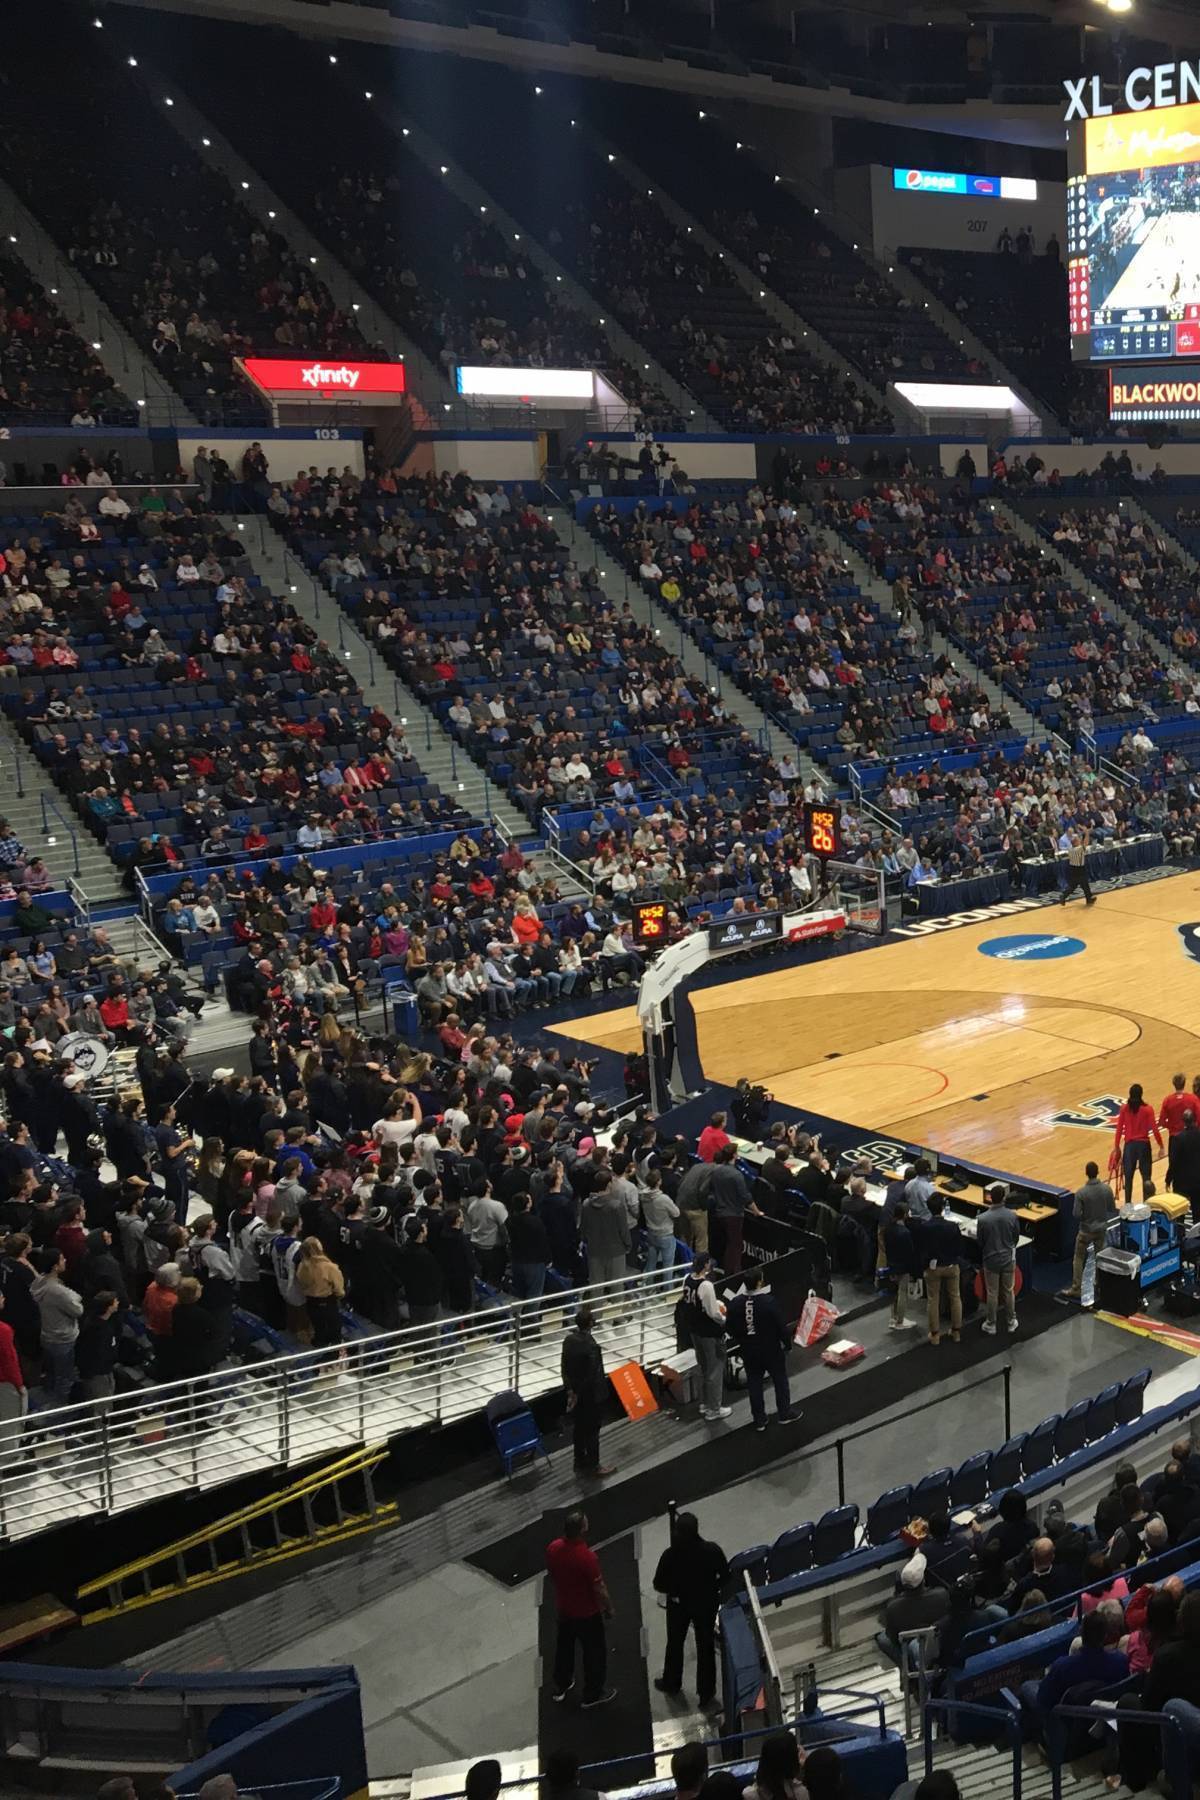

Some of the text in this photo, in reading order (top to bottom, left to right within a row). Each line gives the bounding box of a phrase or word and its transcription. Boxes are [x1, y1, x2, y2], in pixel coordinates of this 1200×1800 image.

[1063, 74, 1112, 121] XL
[967, 220, 988, 232] 207
[302, 364, 359, 388] xfinity
[314, 429, 339, 440] 103
[634, 432, 653, 442] 104
[813, 826, 832, 850] 26
[891, 899, 1043, 937] UCONN
[643, 919, 659, 935] 26
[750, 928, 772, 937] ACURA
[721, 933, 744, 943] ACURA
[745, 1299, 756, 1335] UCONN
